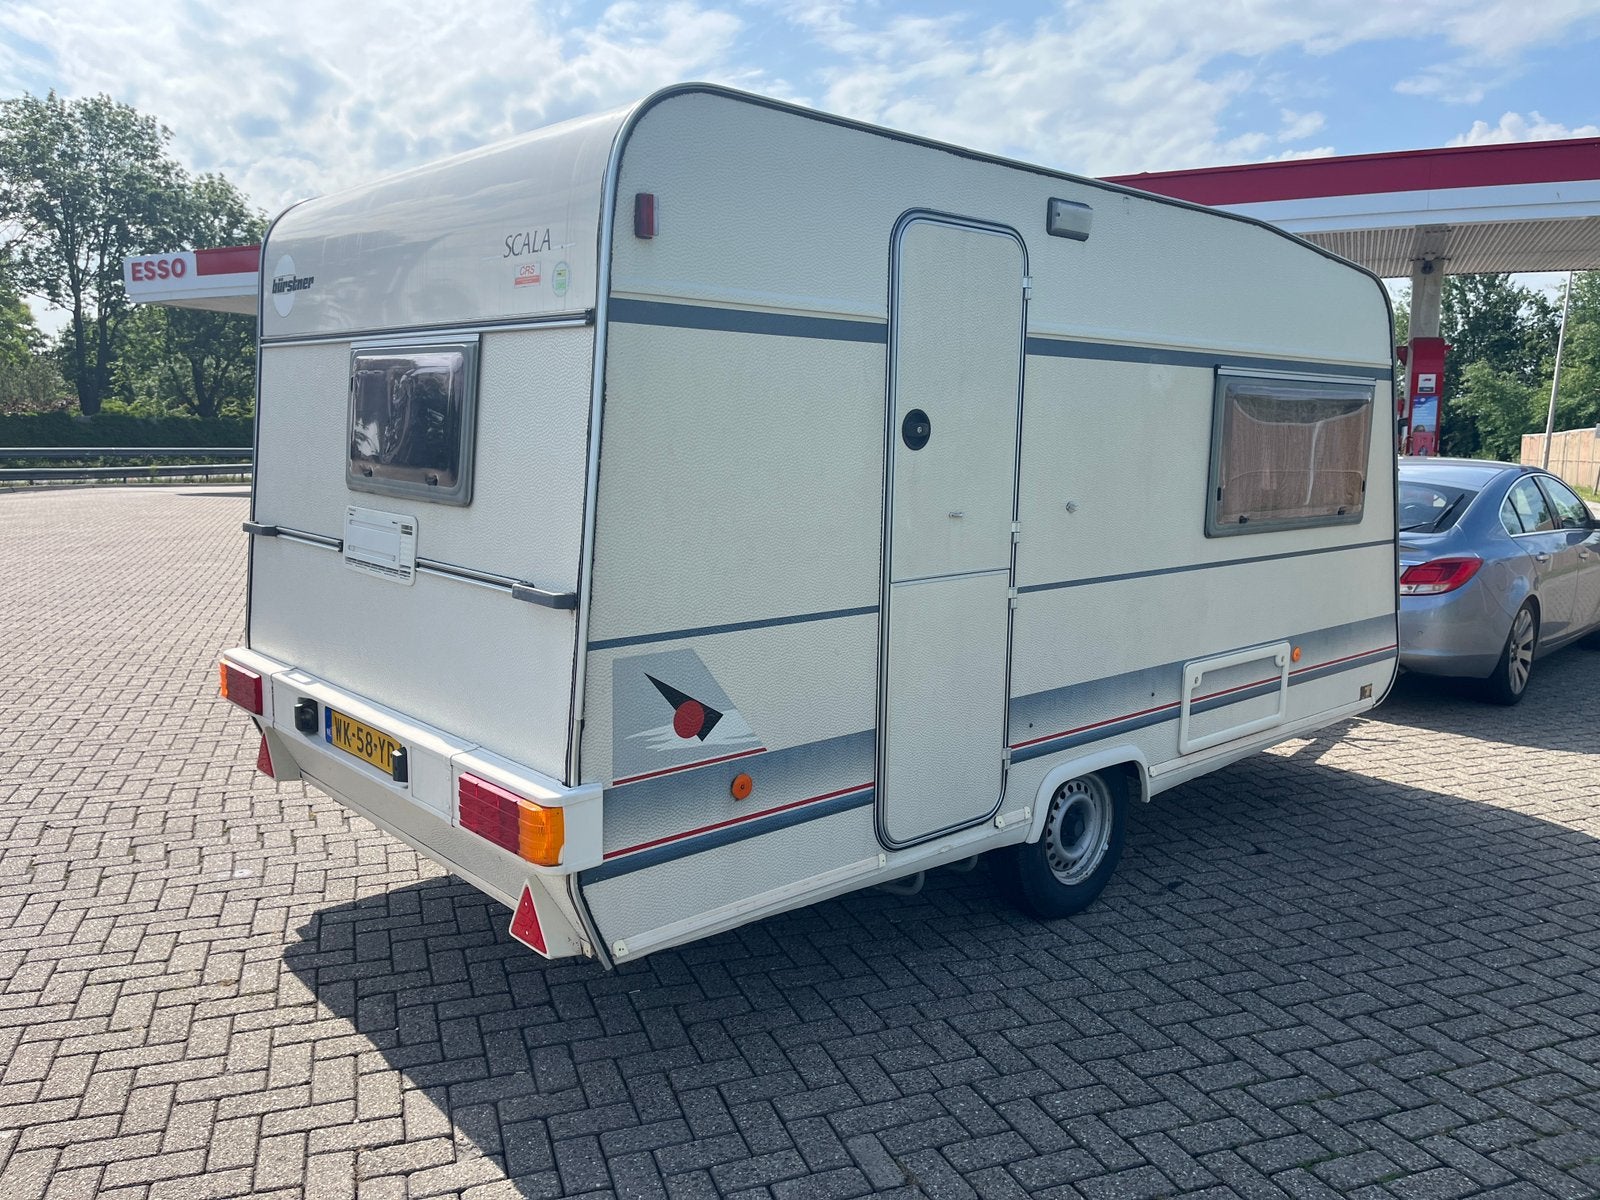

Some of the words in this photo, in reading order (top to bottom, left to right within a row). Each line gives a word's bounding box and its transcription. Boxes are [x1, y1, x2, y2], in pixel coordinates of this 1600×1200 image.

[503, 228, 551, 258] SCALA
[131, 257, 186, 282] ESSO
[272, 275, 314, 294] bürstner
